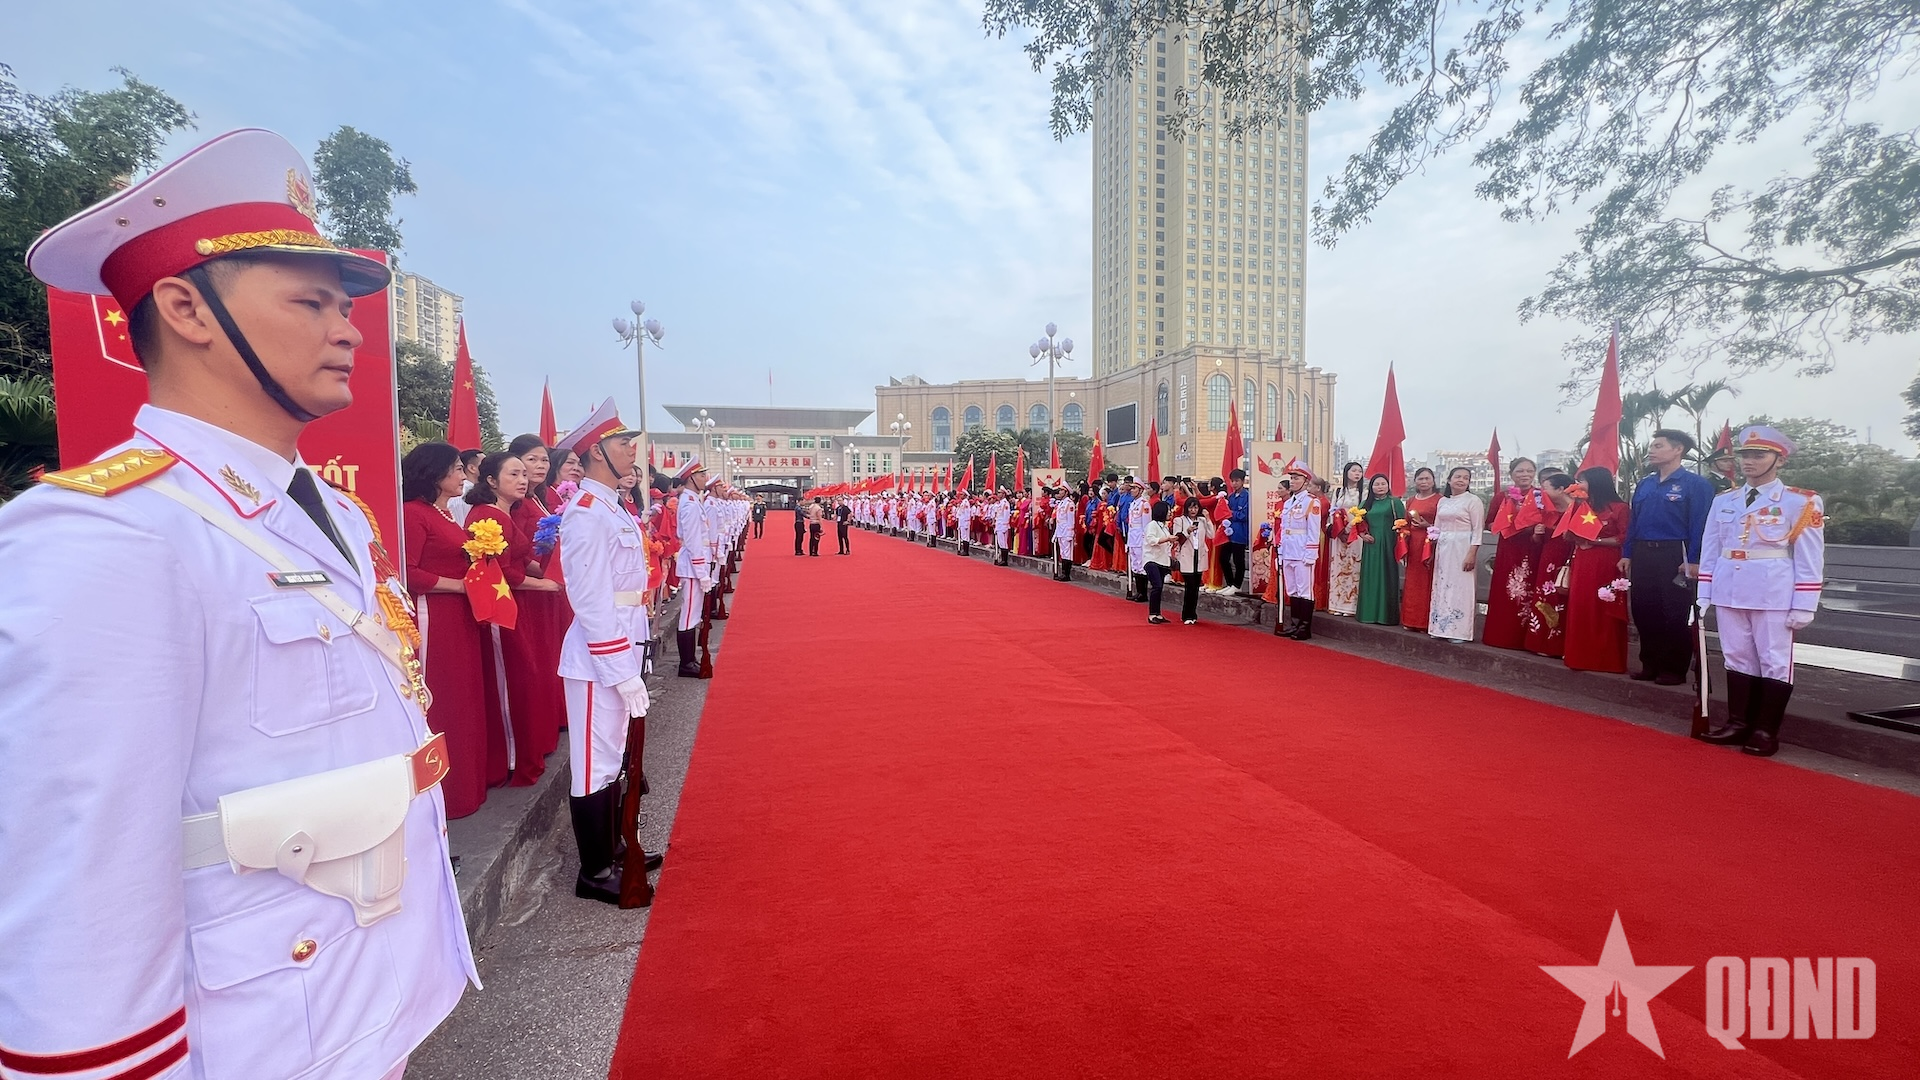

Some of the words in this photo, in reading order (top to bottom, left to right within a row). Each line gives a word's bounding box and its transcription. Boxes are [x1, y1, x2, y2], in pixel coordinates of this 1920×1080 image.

[733, 457, 811, 467] 中华人民共和国
